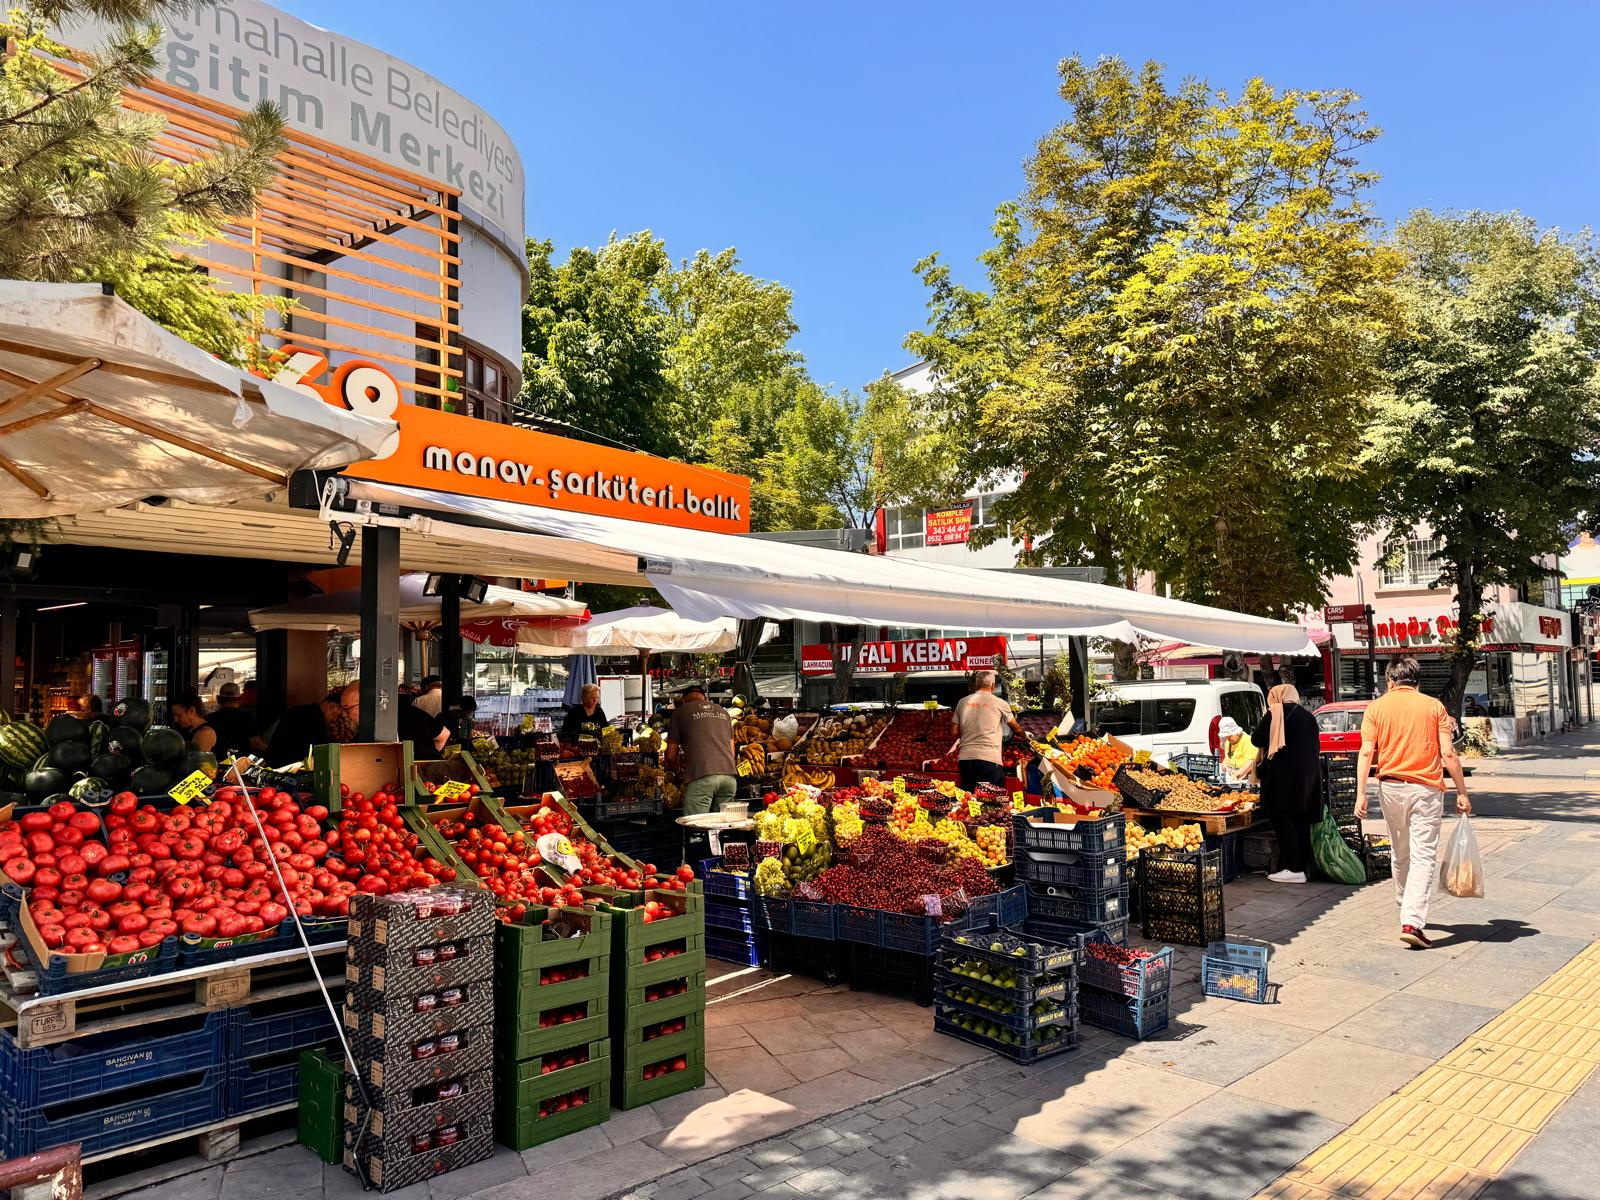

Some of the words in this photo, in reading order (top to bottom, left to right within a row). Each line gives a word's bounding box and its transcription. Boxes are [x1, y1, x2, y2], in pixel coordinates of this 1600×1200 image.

[183, 0, 374, 97] mahalle
[350, 100, 505, 220] Merkezi
[936, 510, 964, 518] KOMPLE
[901, 640, 968, 663] KEBAP
[803, 661, 833, 669] LAHMACUN
